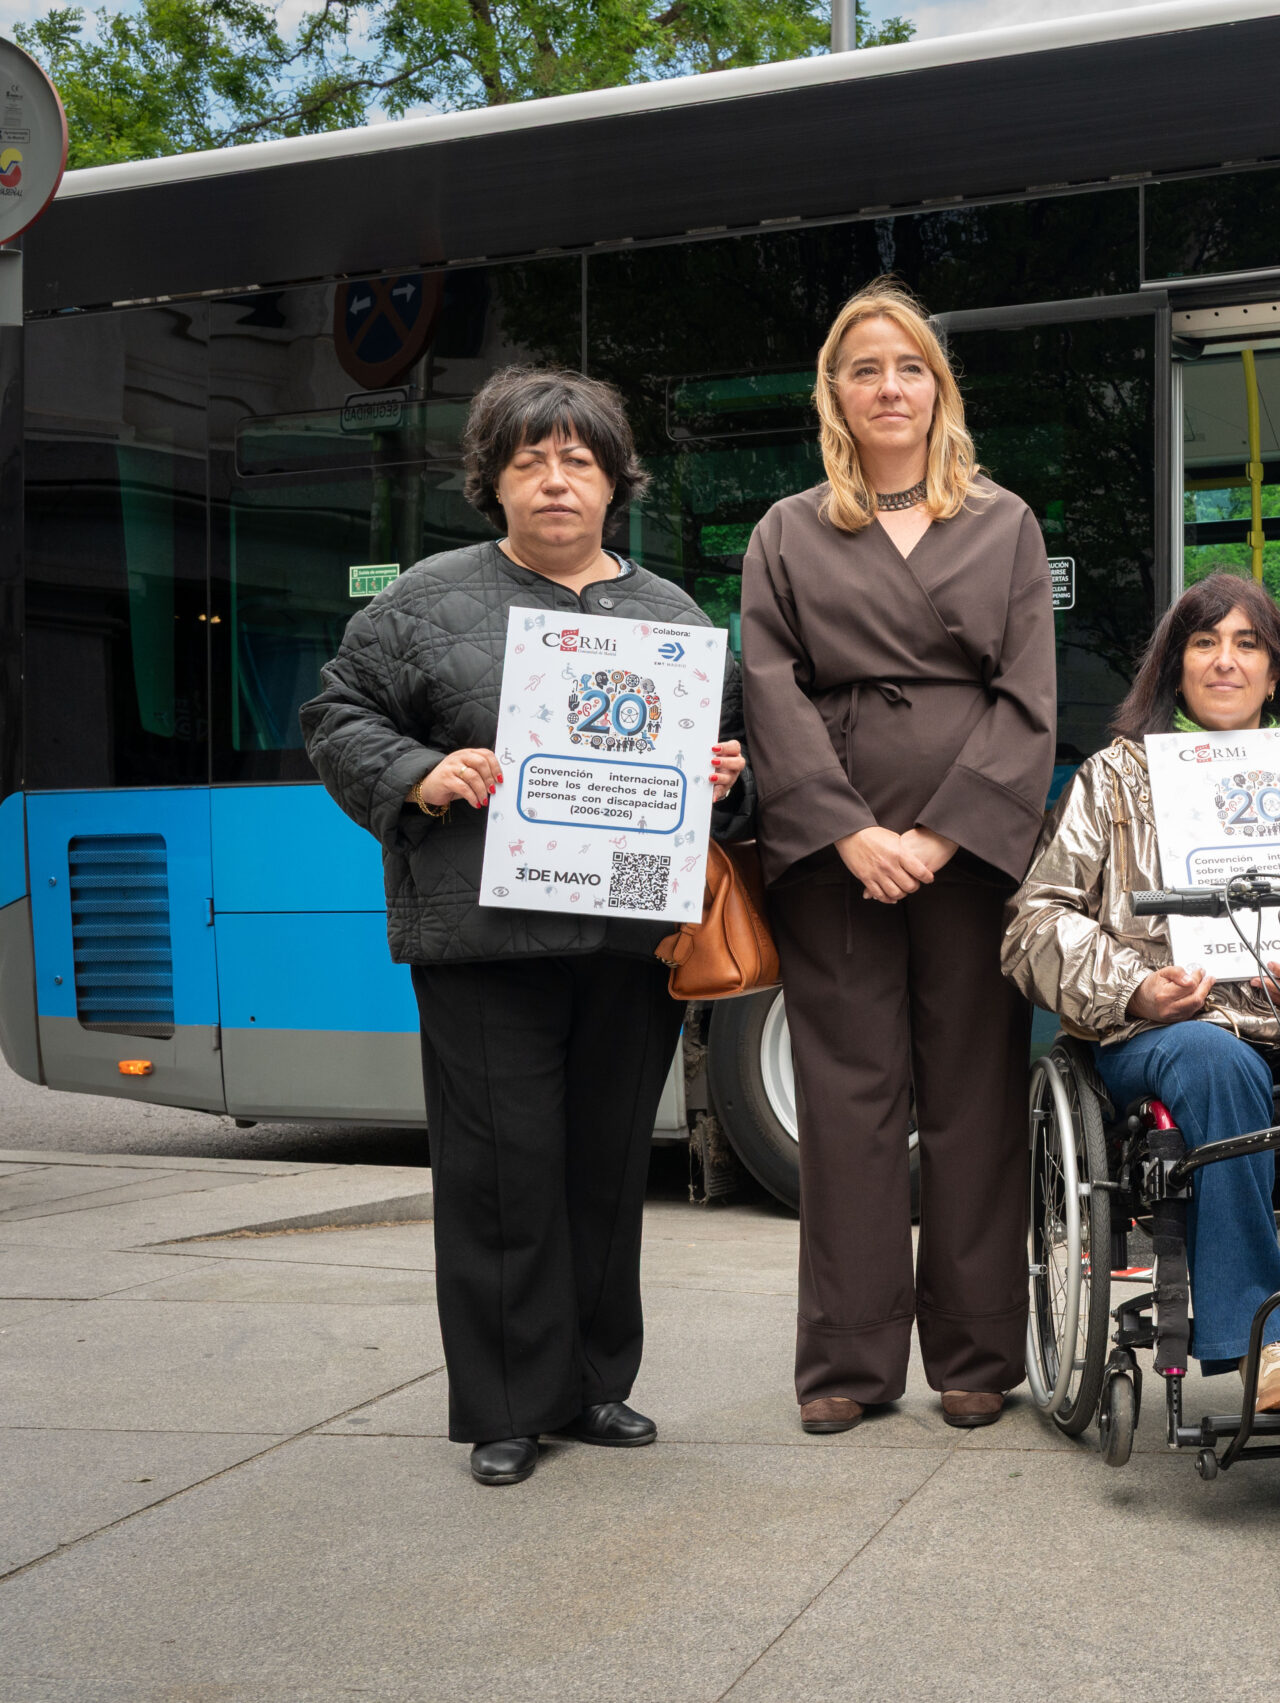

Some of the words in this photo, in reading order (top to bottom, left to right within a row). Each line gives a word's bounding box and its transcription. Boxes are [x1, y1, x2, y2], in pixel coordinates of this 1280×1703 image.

[653, 627, 691, 638] Colabora:
[577, 689, 647, 736] 20
[529, 765, 593, 779] Convención
[609, 771, 679, 787] internacional
[528, 777, 559, 788] sobre
[565, 779, 581, 790] los
[587, 782, 637, 796] derechos
[643, 787, 657, 797] de
[663, 789, 678, 799] las
[527, 790, 577, 802] personas
[582, 795, 601, 804] con
[607, 795, 677, 811] discapacidad
[570, 804, 633, 820] (2006-2026)
[1195, 855, 1253, 865] Convención
[515, 867, 526, 880] 3
[528, 868, 551, 882] DE
[554, 871, 602, 886] MAYO
[1196, 866, 1224, 875] sobre
[1230, 864, 1245, 873] los
[1203, 944, 1213, 955] 3
[1216, 942, 1237, 954] DE
